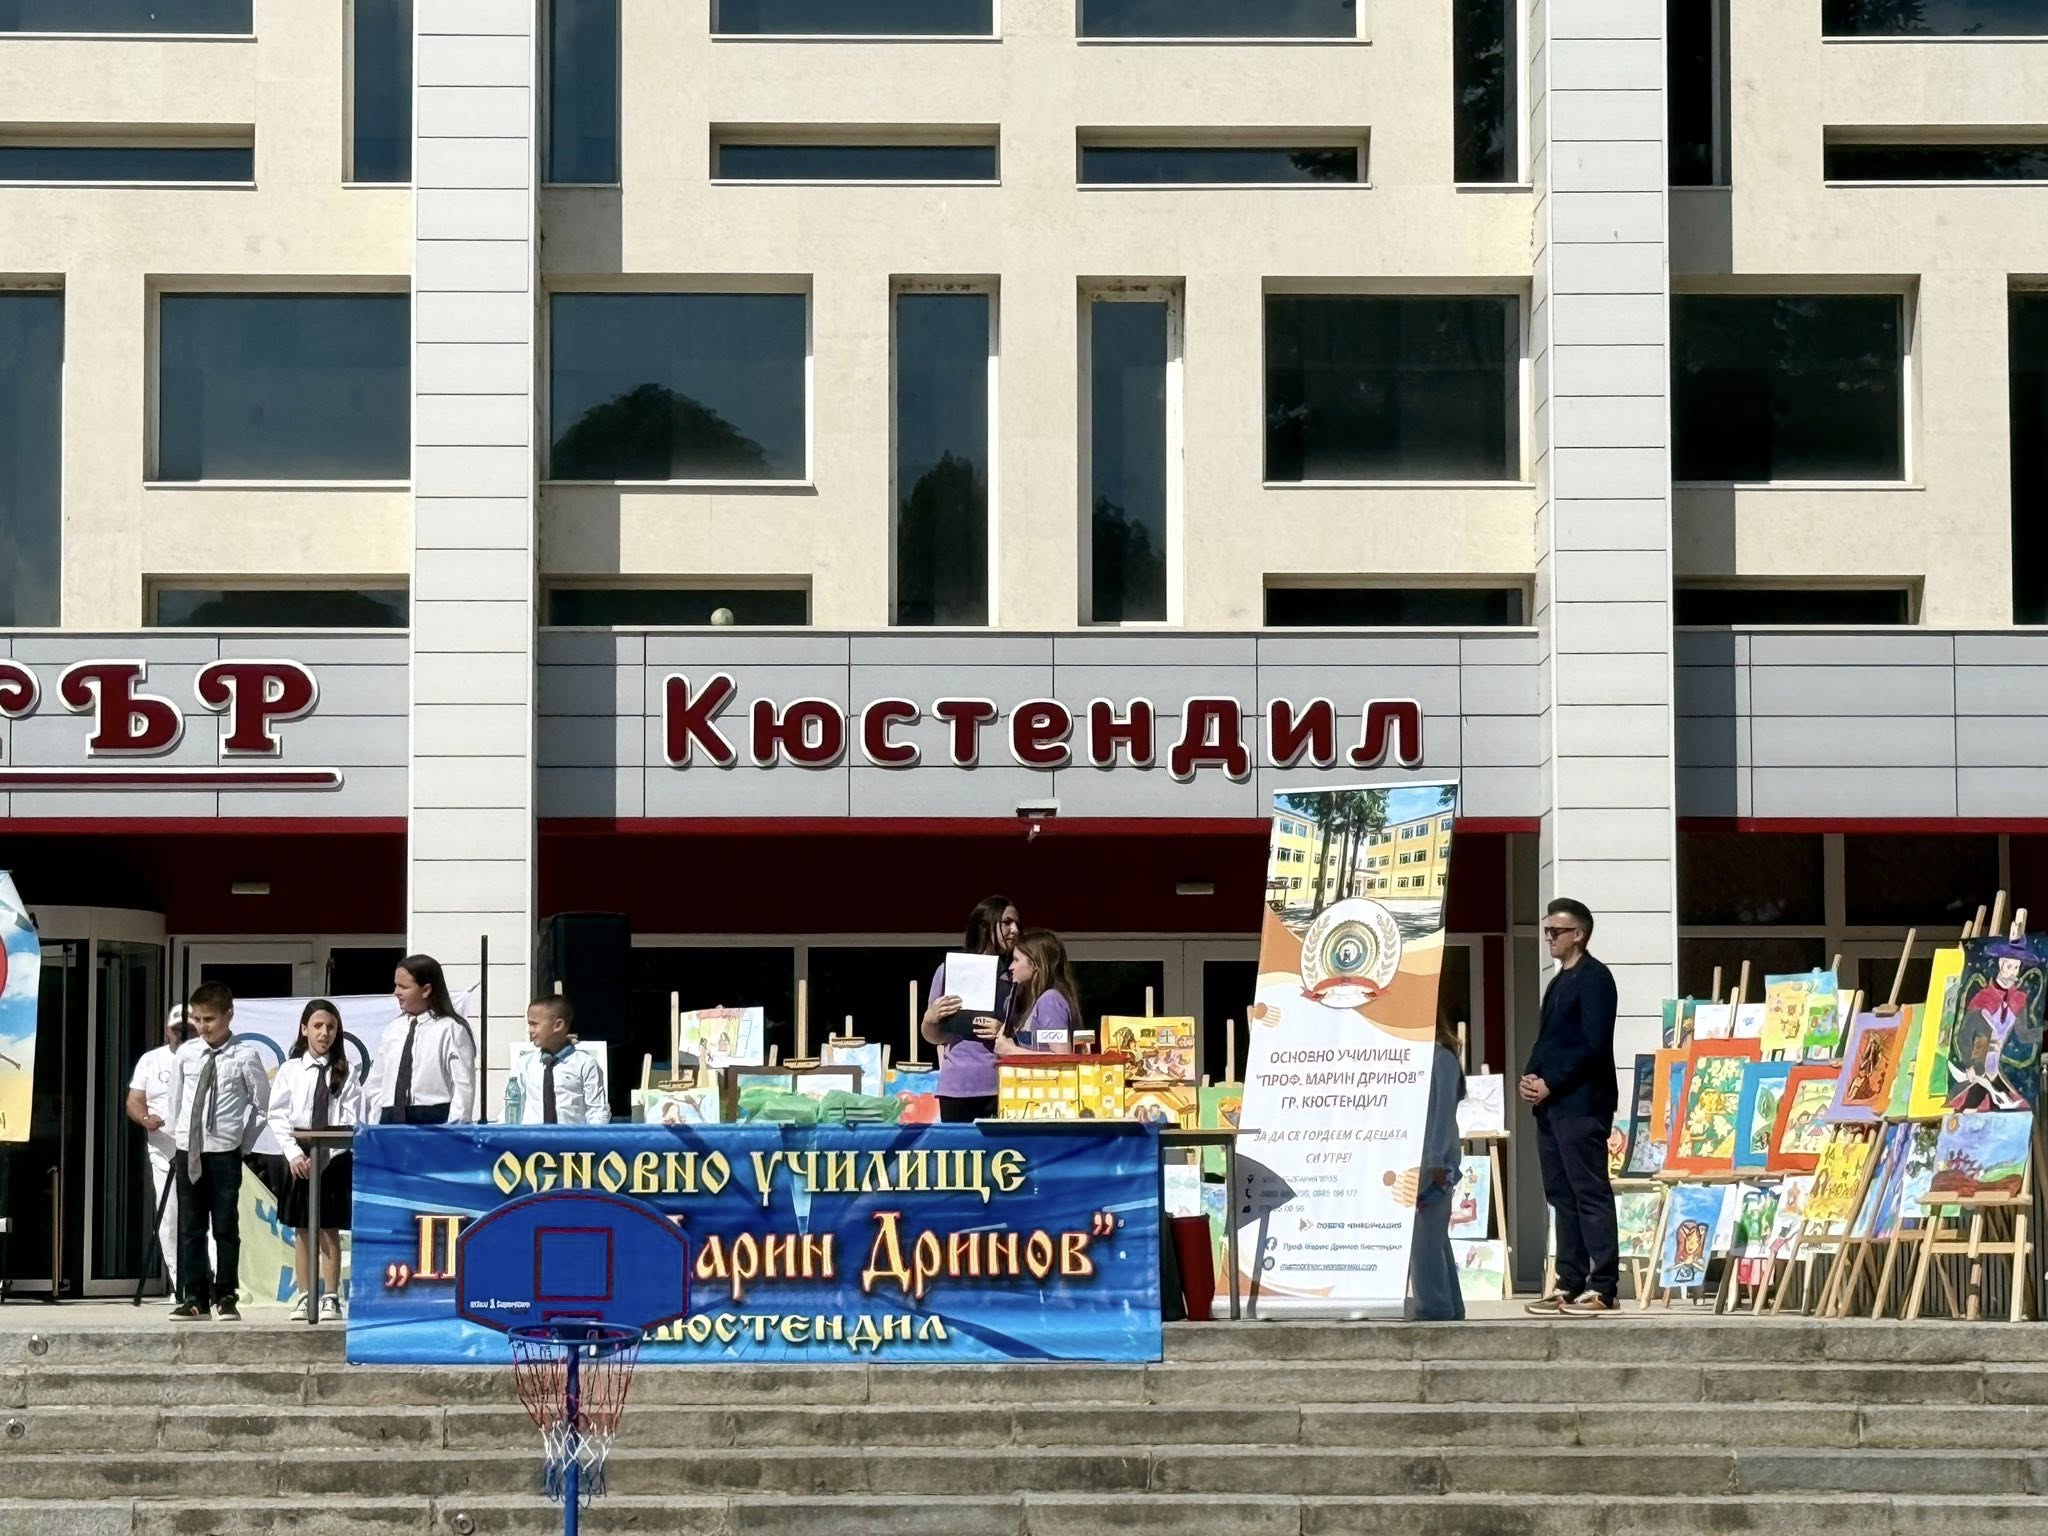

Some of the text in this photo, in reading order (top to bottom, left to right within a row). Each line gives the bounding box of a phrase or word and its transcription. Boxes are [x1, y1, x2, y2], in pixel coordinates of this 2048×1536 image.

[0, 658, 320, 758] ЪР
[662, 672, 1424, 780] Кюстендил
[1270, 1048, 1411, 1064] ОСНОВНО УЧИЛИЩЕ
[1305, 1072, 1355, 1086] МАРИН
[1301, 1094, 1388, 1111] КЮСТЕНДИЛ
[493, 1149, 1026, 1206] ОСНОВНО УЧИЛИЩЕ
[672, 1214, 834, 1300] арин
